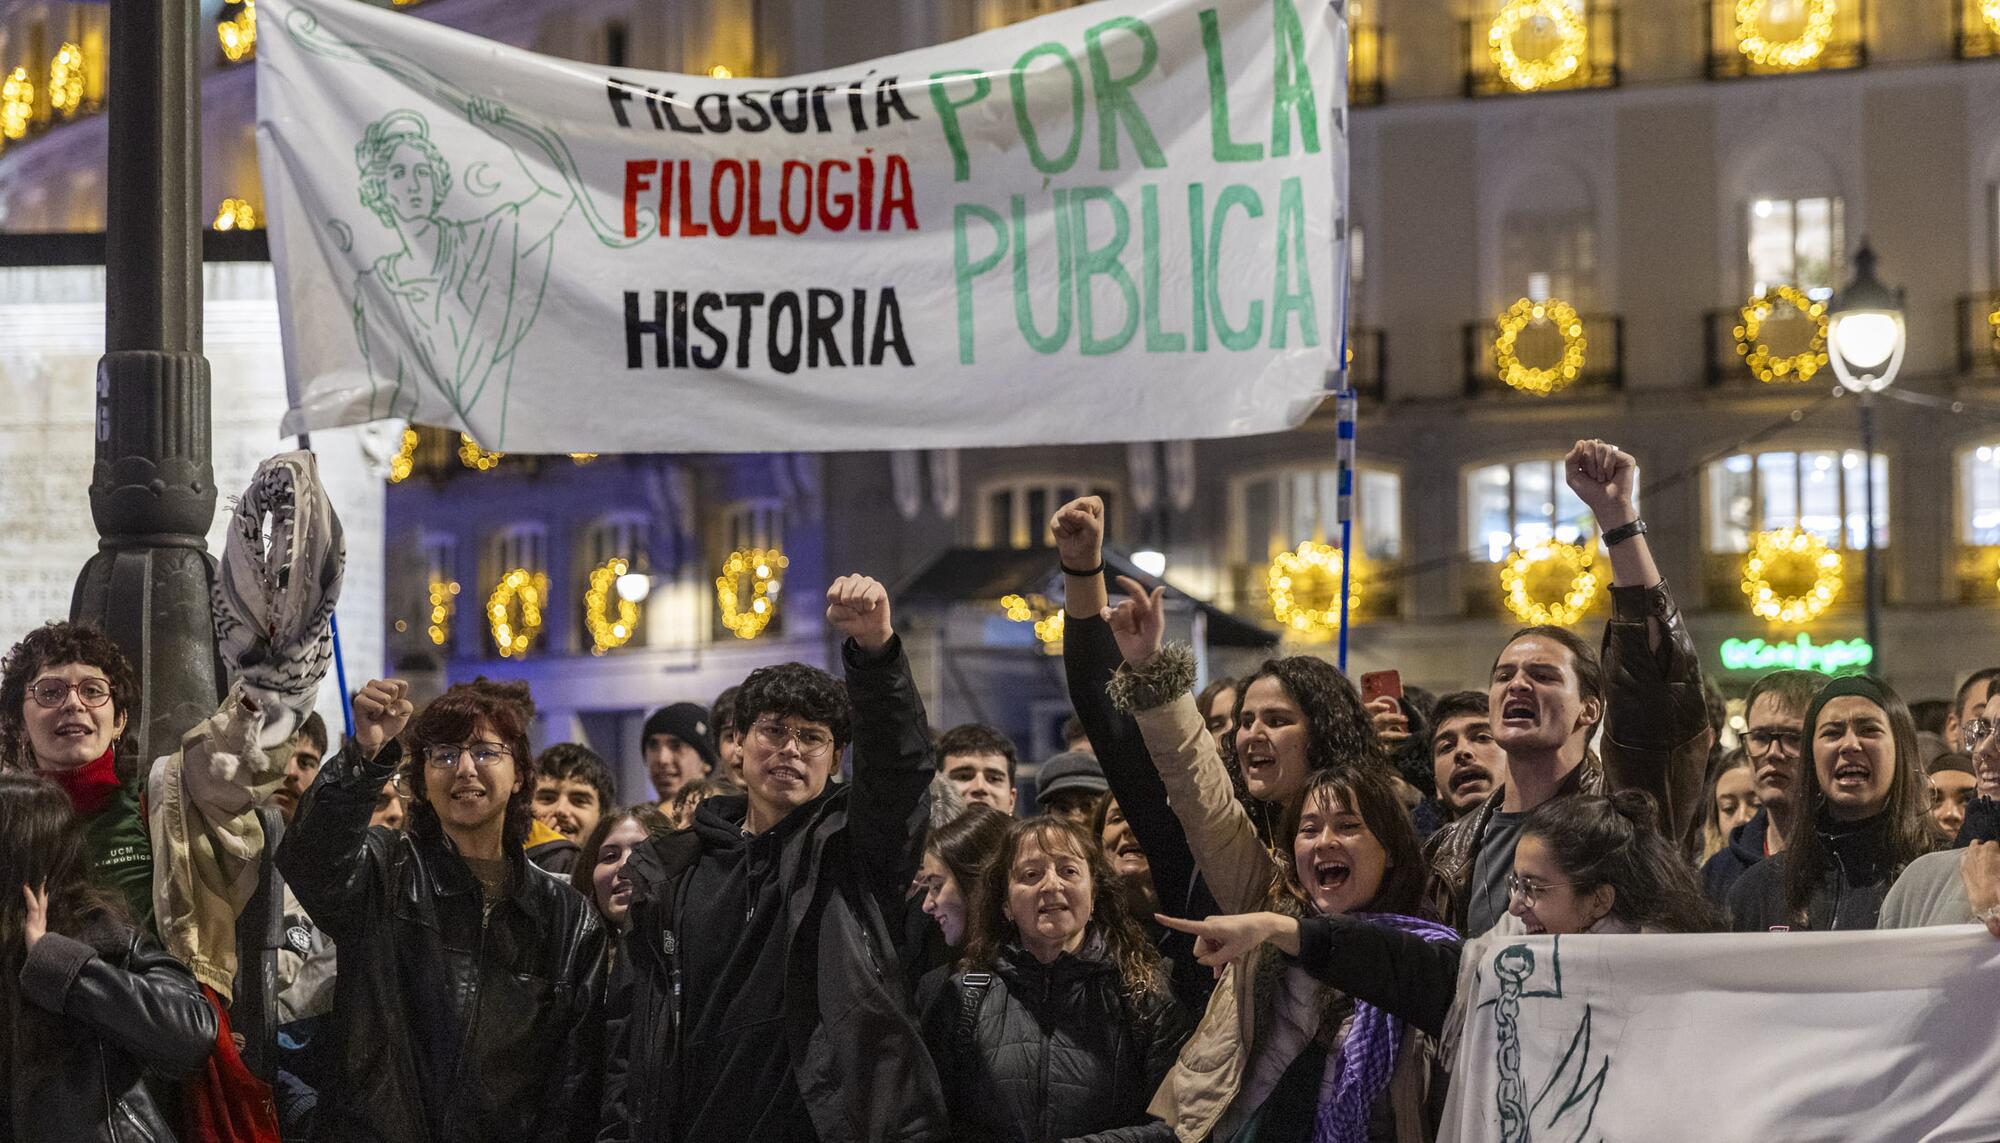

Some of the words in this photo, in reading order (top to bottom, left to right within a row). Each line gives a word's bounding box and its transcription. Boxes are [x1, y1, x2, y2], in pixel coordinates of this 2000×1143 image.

[929, 15, 1168, 182] POR
[1198, 0, 1321, 162] LA
[623, 147, 920, 238] FILOLOGÍA
[953, 176, 1321, 365] PÚBLICA
[624, 287, 916, 374] HISTORIA
[110, 846, 133, 857] UCM
